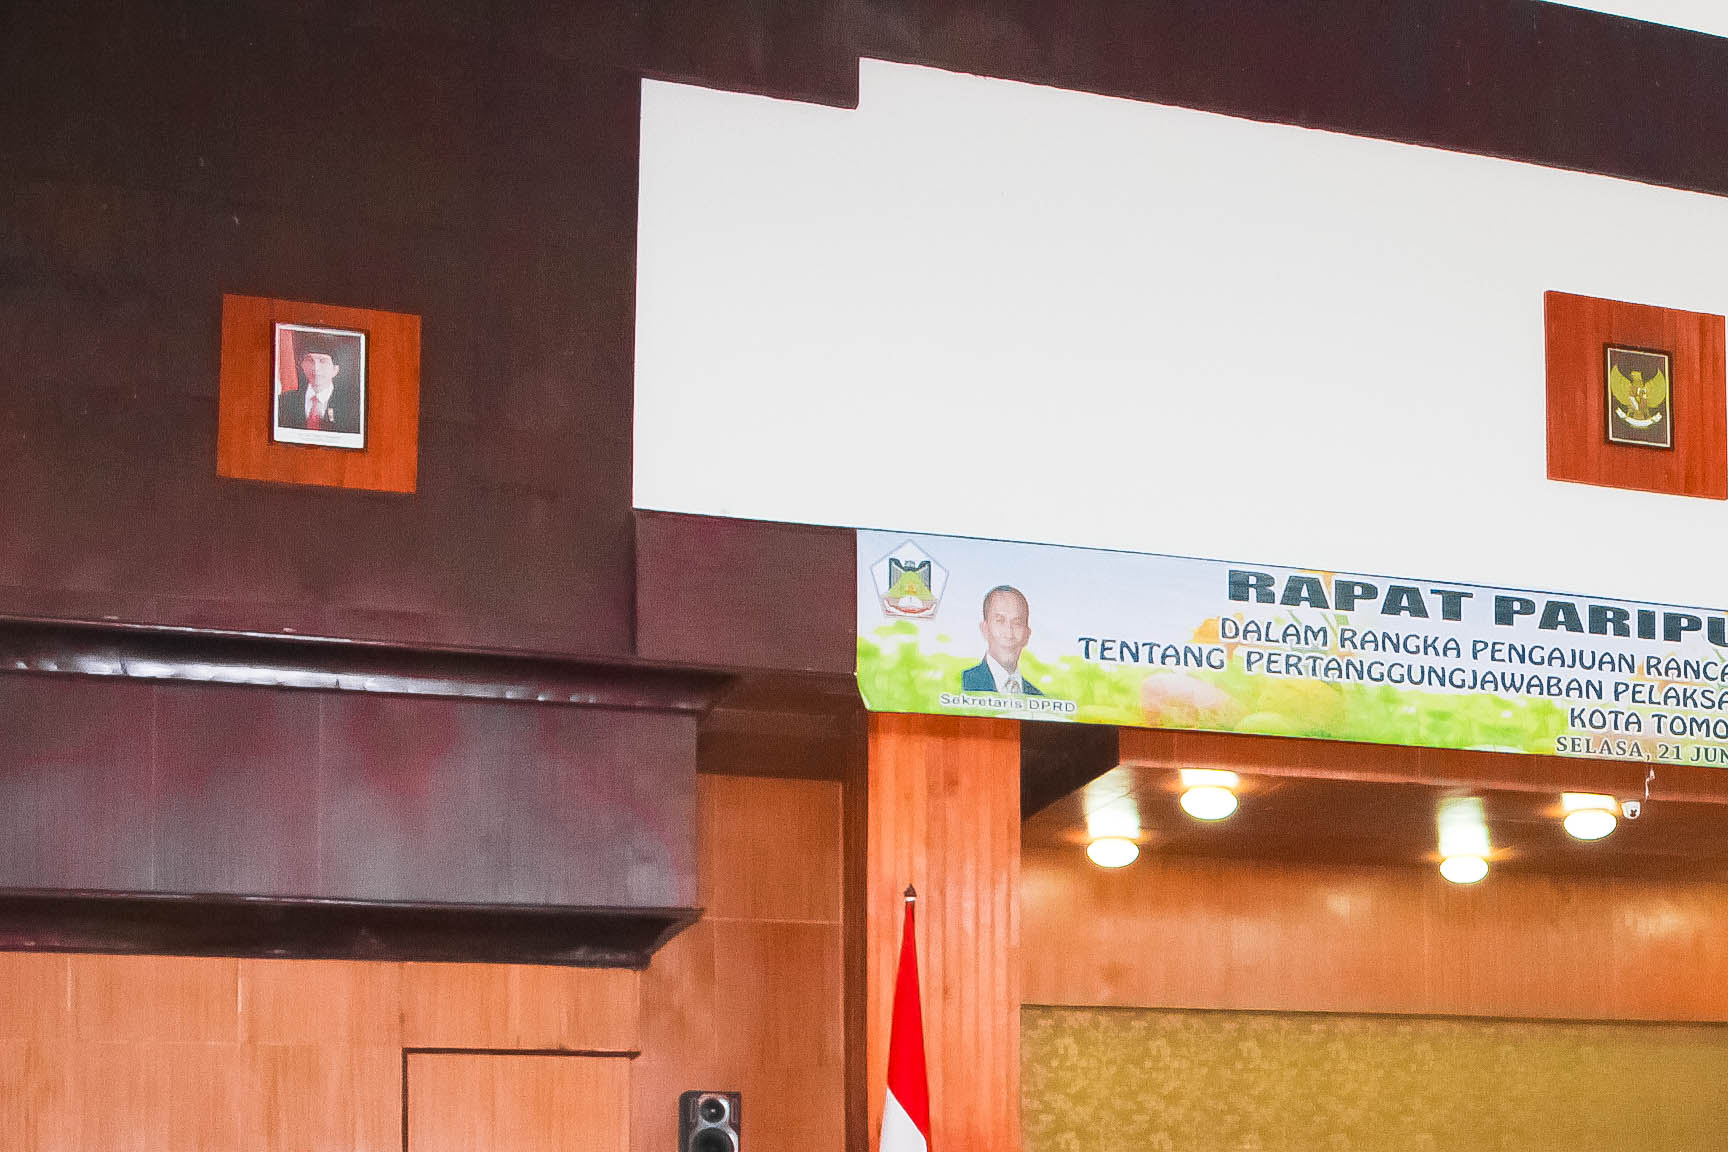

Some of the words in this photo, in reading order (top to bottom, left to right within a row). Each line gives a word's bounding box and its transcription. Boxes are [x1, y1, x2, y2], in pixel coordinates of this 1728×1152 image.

[1228, 569, 1474, 622] RAPAT
[1220, 617, 1329, 648] DALAM
[1339, 628, 1461, 659] RANGKA
[1472, 639, 1636, 675] PENGAJUAN
[1078, 637, 1226, 670] TENTANG
[1245, 651, 1604, 701] PERTANGGUNGJAWABAN
[939, 693, 1023, 710] Sekretaris
[1028, 699, 1076, 713] DPRD
[1569, 707, 1643, 732] KOTA
[1556, 736, 1652, 762] SELASA,
[1658, 744, 1682, 760] 21
